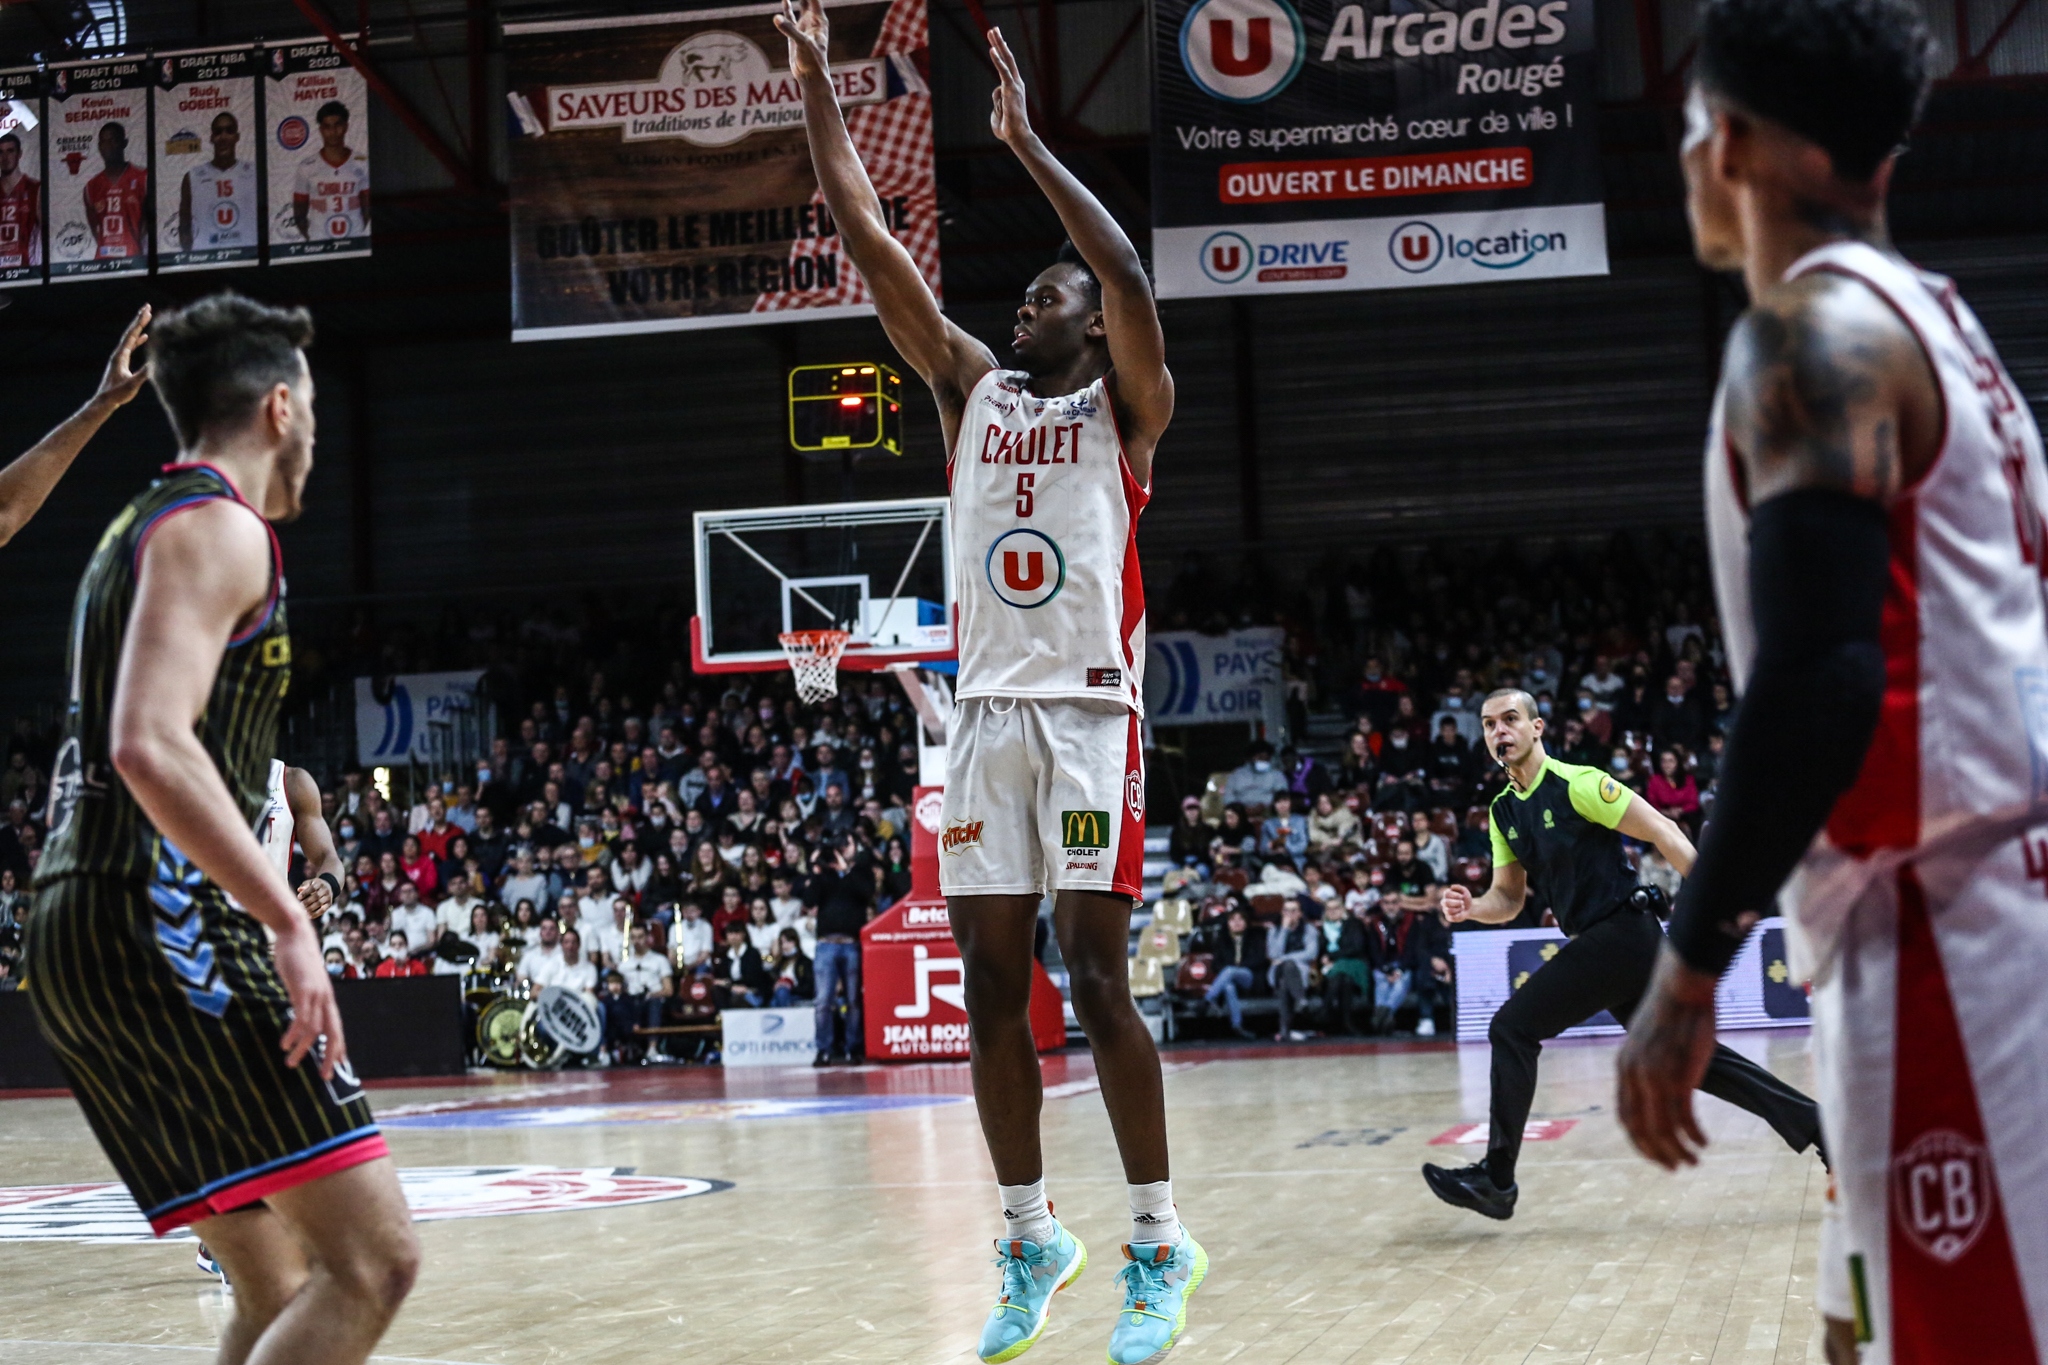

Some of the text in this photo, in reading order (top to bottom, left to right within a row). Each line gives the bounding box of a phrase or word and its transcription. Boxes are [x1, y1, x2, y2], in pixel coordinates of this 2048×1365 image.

[1210, 0, 1568, 77] U Arcades
[180, 52, 246, 69] DRAFT NBA
[290, 45, 328, 58] DRAFT
[308, 56, 341, 69] 2020
[7, 75, 32, 85] NBA
[73, 64, 139, 80] DRAFT NBA
[197, 66, 229, 79] 2013
[296, 75, 336, 87] Killian
[1456, 56, 1565, 97] Rougé
[90, 78, 122, 91] 2010
[189, 85, 220, 98] Rudy
[293, 86, 338, 102] HAYES
[178, 97, 231, 112] GOBERT
[557, 87, 686, 122] SAVEURS
[694, 86, 737, 109] DES
[632, 115, 712, 135] traditions
[715, 110, 736, 127] de
[1176, 126, 1242, 151] Votre
[1248, 115, 1400, 152] supermarché
[1479, 109, 1510, 134] de
[1517, 106, 1558, 131] ville
[216, 179, 234, 198] 15
[1226, 157, 1527, 197] OUVERT LE DIMANCHE
[668, 214, 700, 250] LE
[709, 203, 838, 248] MEILLEU
[1257, 240, 1350, 266] DRIVE
[1447, 227, 1568, 259] location
[607, 263, 711, 305] VOTRE
[981, 422, 1083, 465] CHOLET
[1015, 472, 1035, 518] 5
[1003, 551, 1045, 592] U
[1206, 688, 1262, 713] LOIR
[1067, 848, 1101, 857] CHOLET
[1065, 862, 1098, 871] SPALDING
[883, 1022, 970, 1046] JEAN ROU
[1910, 1159, 1976, 1232] CB
